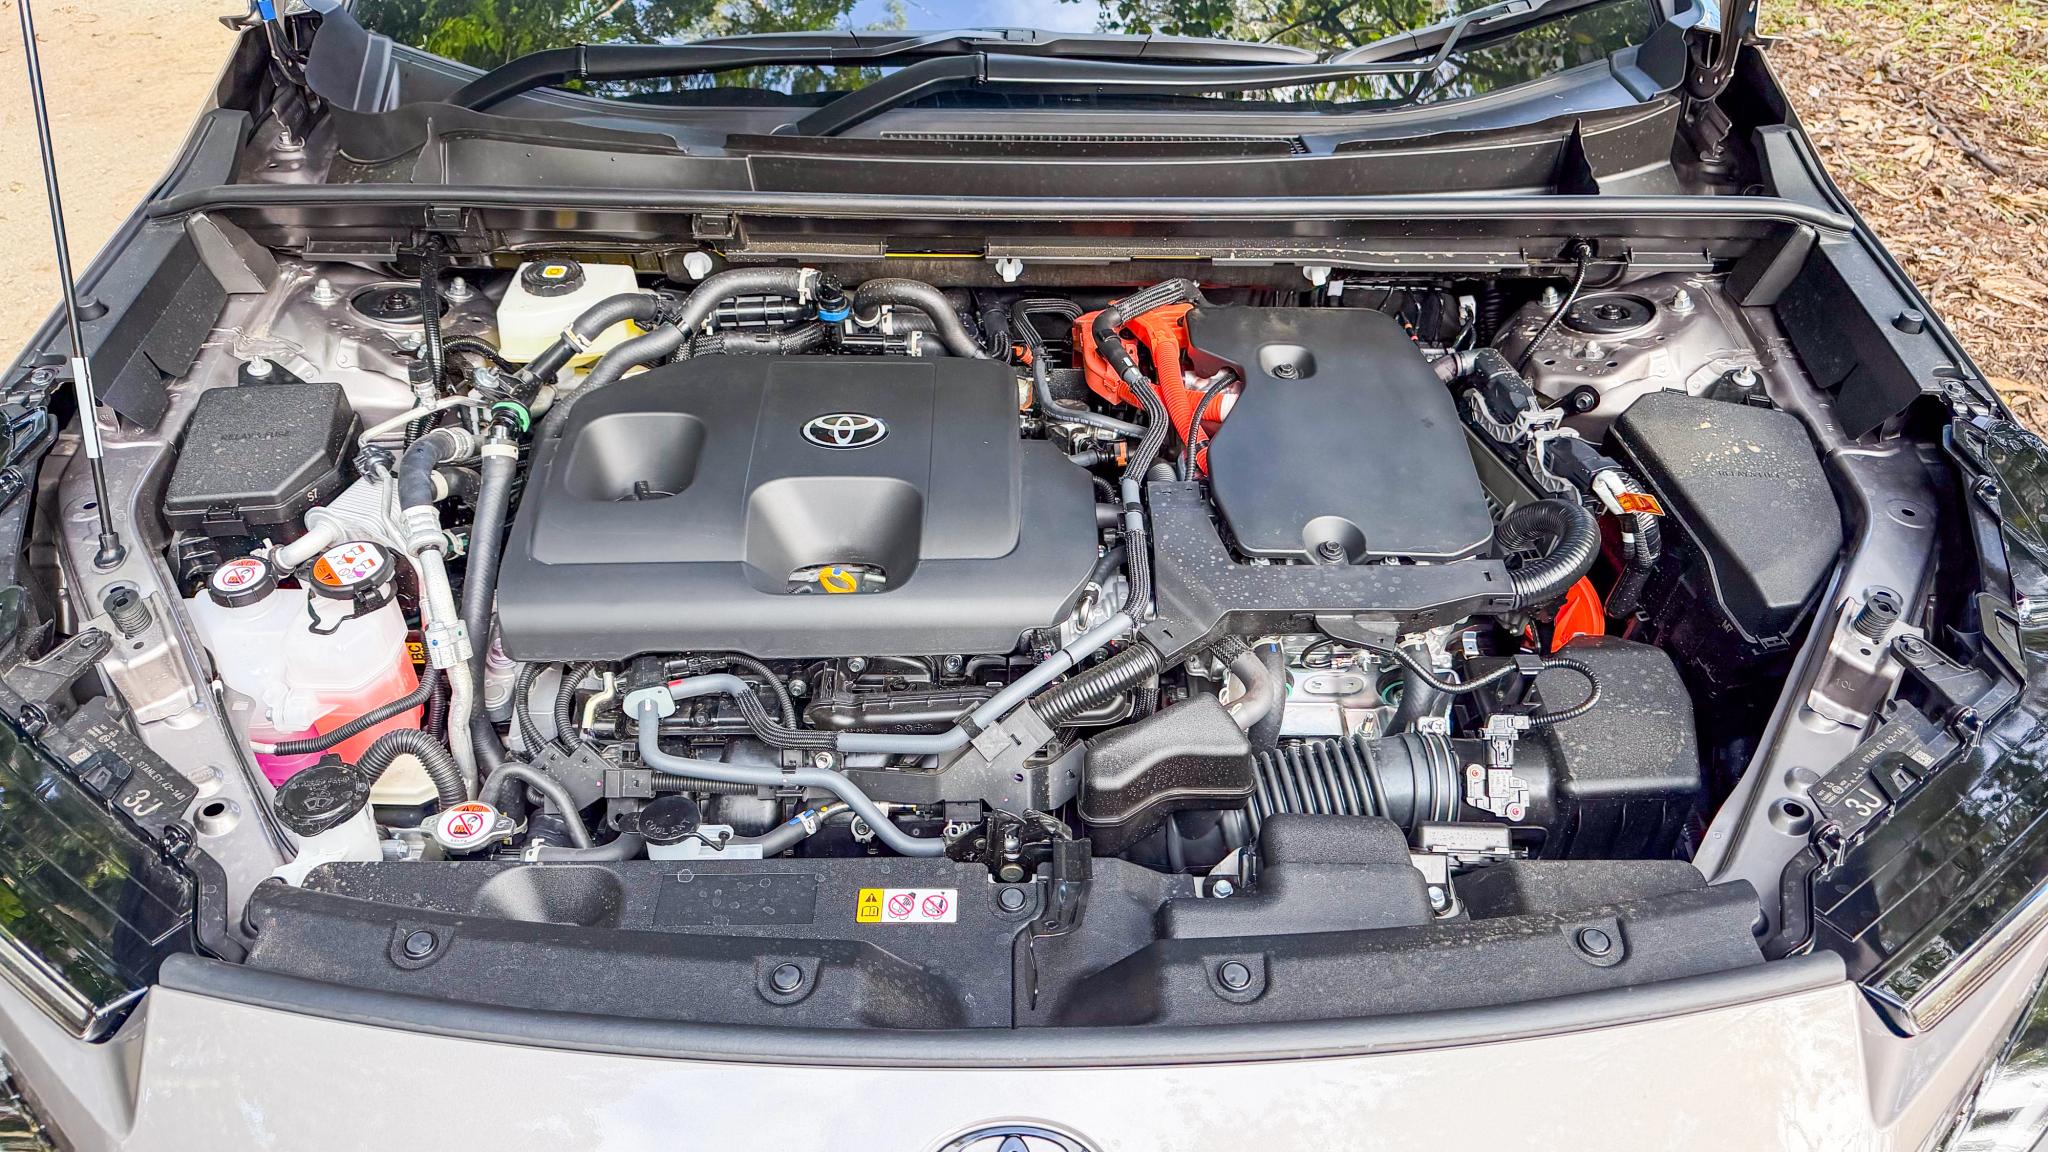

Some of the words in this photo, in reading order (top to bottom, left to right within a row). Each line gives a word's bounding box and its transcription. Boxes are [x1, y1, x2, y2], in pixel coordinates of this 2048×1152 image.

[307, 487, 318, 502] S7
[1862, 742, 1889, 764] STANLEY
[136, 760, 164, 785] STANLEY
[122, 789, 164, 817] 3J
[1844, 787, 1882, 817] 3J
[645, 819, 690, 836] COOLANT
